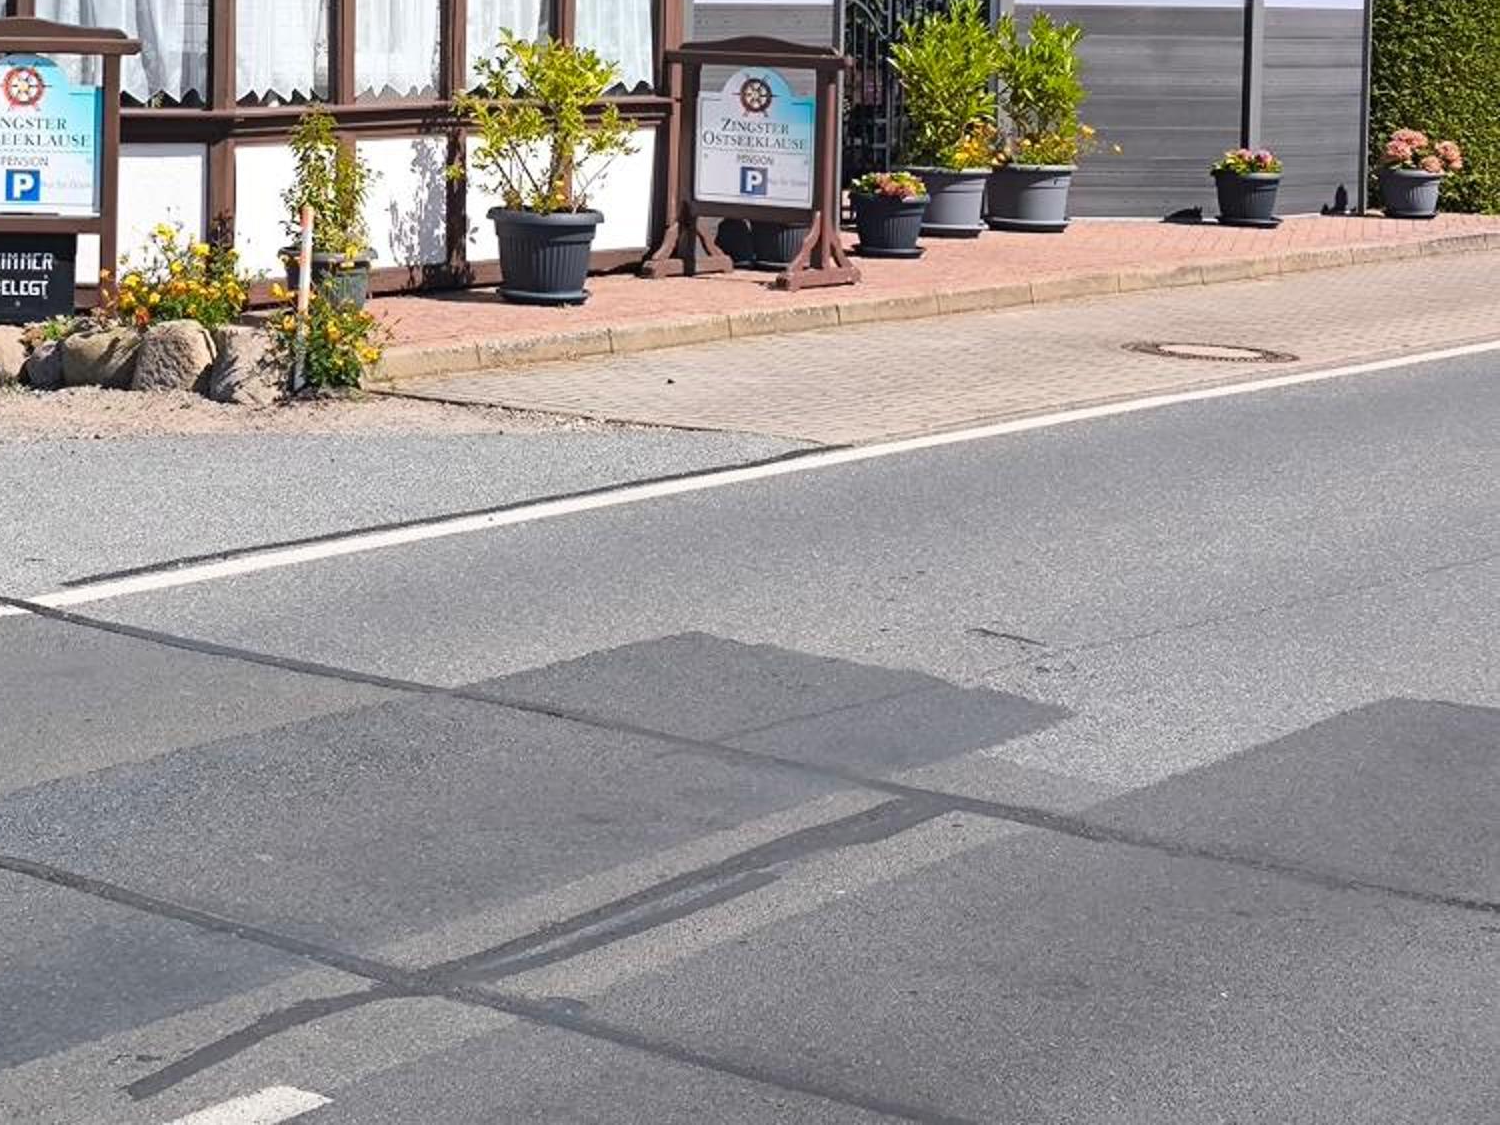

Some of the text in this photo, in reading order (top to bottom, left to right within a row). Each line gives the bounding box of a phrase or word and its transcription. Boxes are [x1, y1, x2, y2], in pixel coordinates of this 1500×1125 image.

[721, 118, 789, 135] ZINGSTER
[703, 130, 805, 149] OSTSEEKLAUSE
[0, 155, 49, 167] PENSION
[737, 154, 773, 165] PENSION
[12, 173, 35, 200] P
